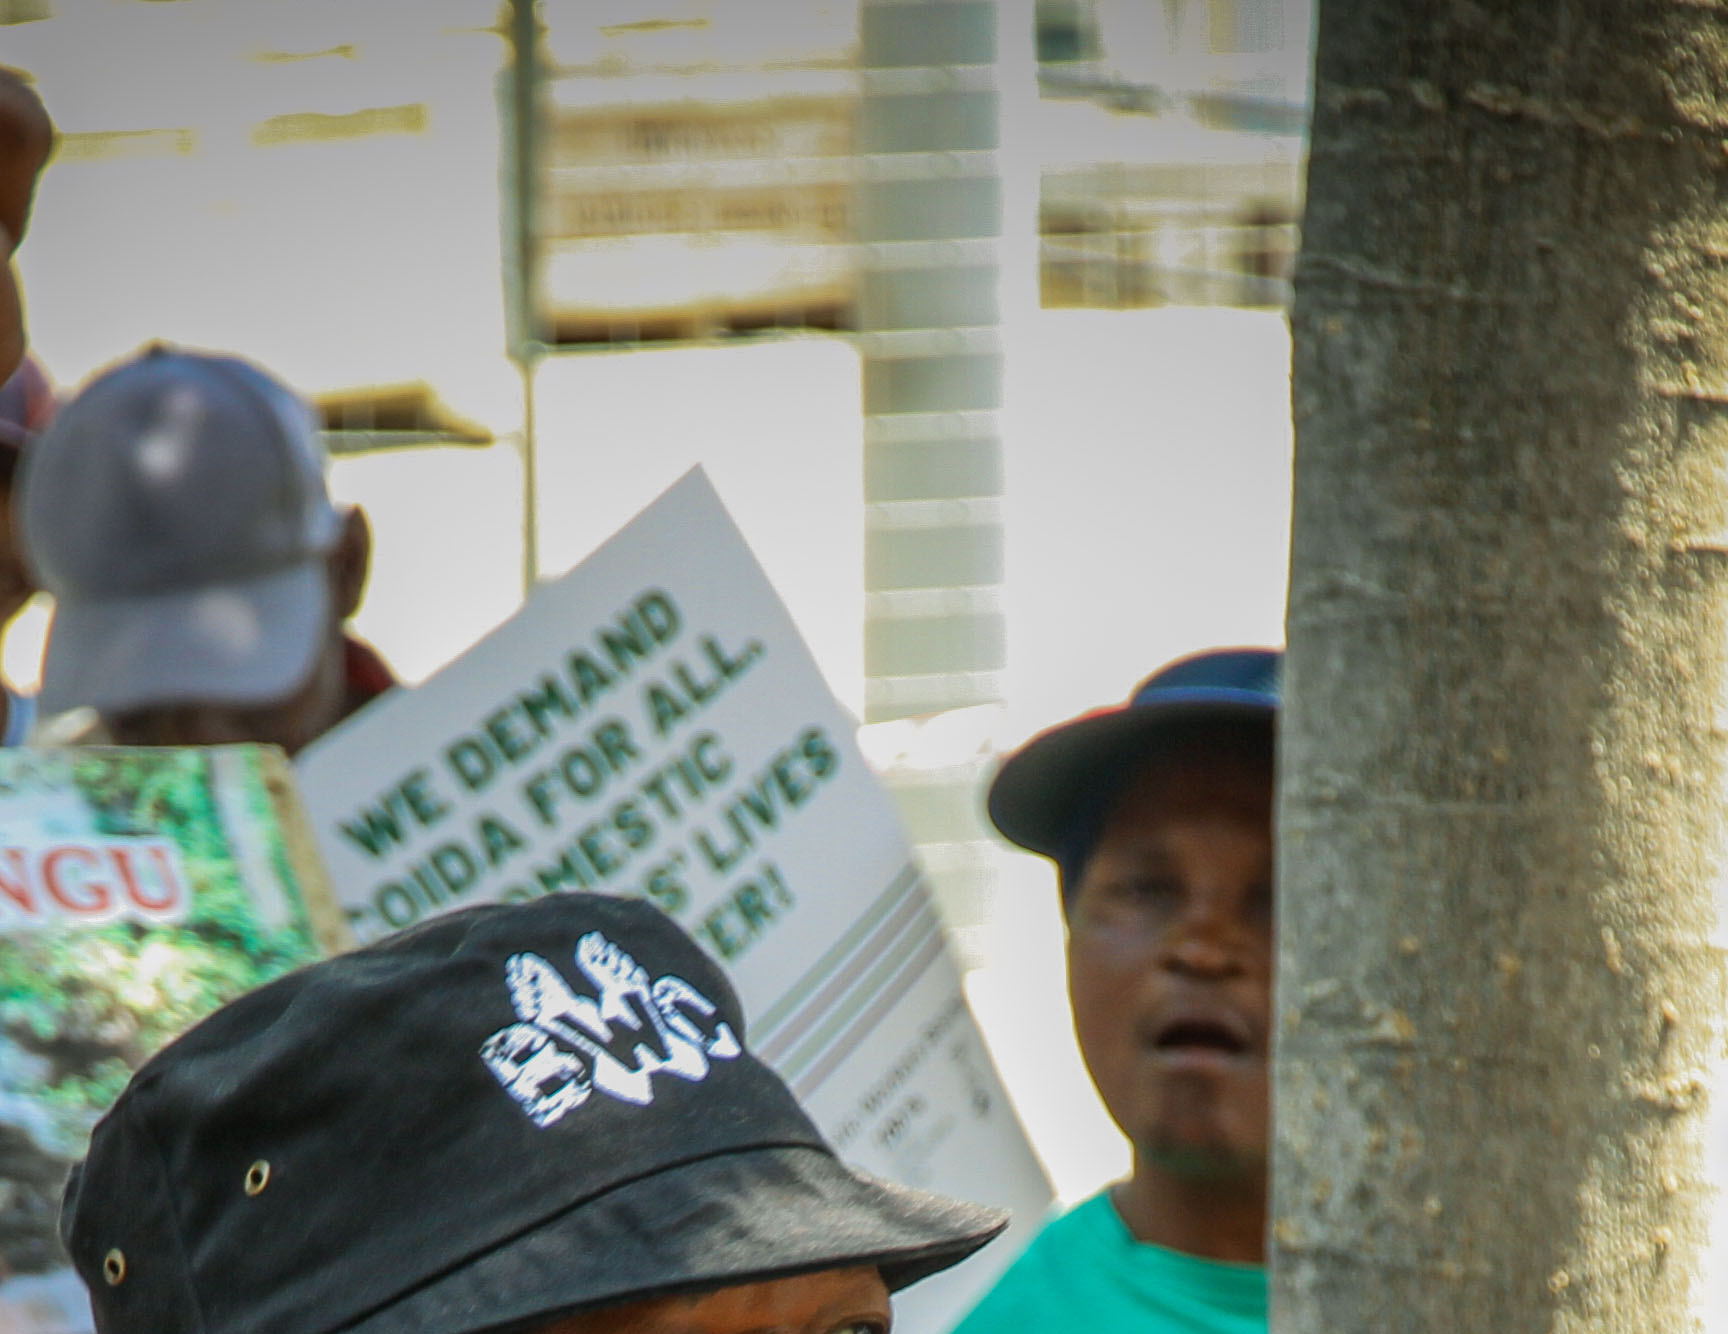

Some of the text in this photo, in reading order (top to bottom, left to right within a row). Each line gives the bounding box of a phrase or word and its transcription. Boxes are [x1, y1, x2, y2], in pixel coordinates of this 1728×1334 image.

[339, 586, 684, 860] WE DEMAND
[523, 715, 640, 830] FOR
[696, 724, 842, 876] LIVES
[500, 728, 736, 902] MESTIC
